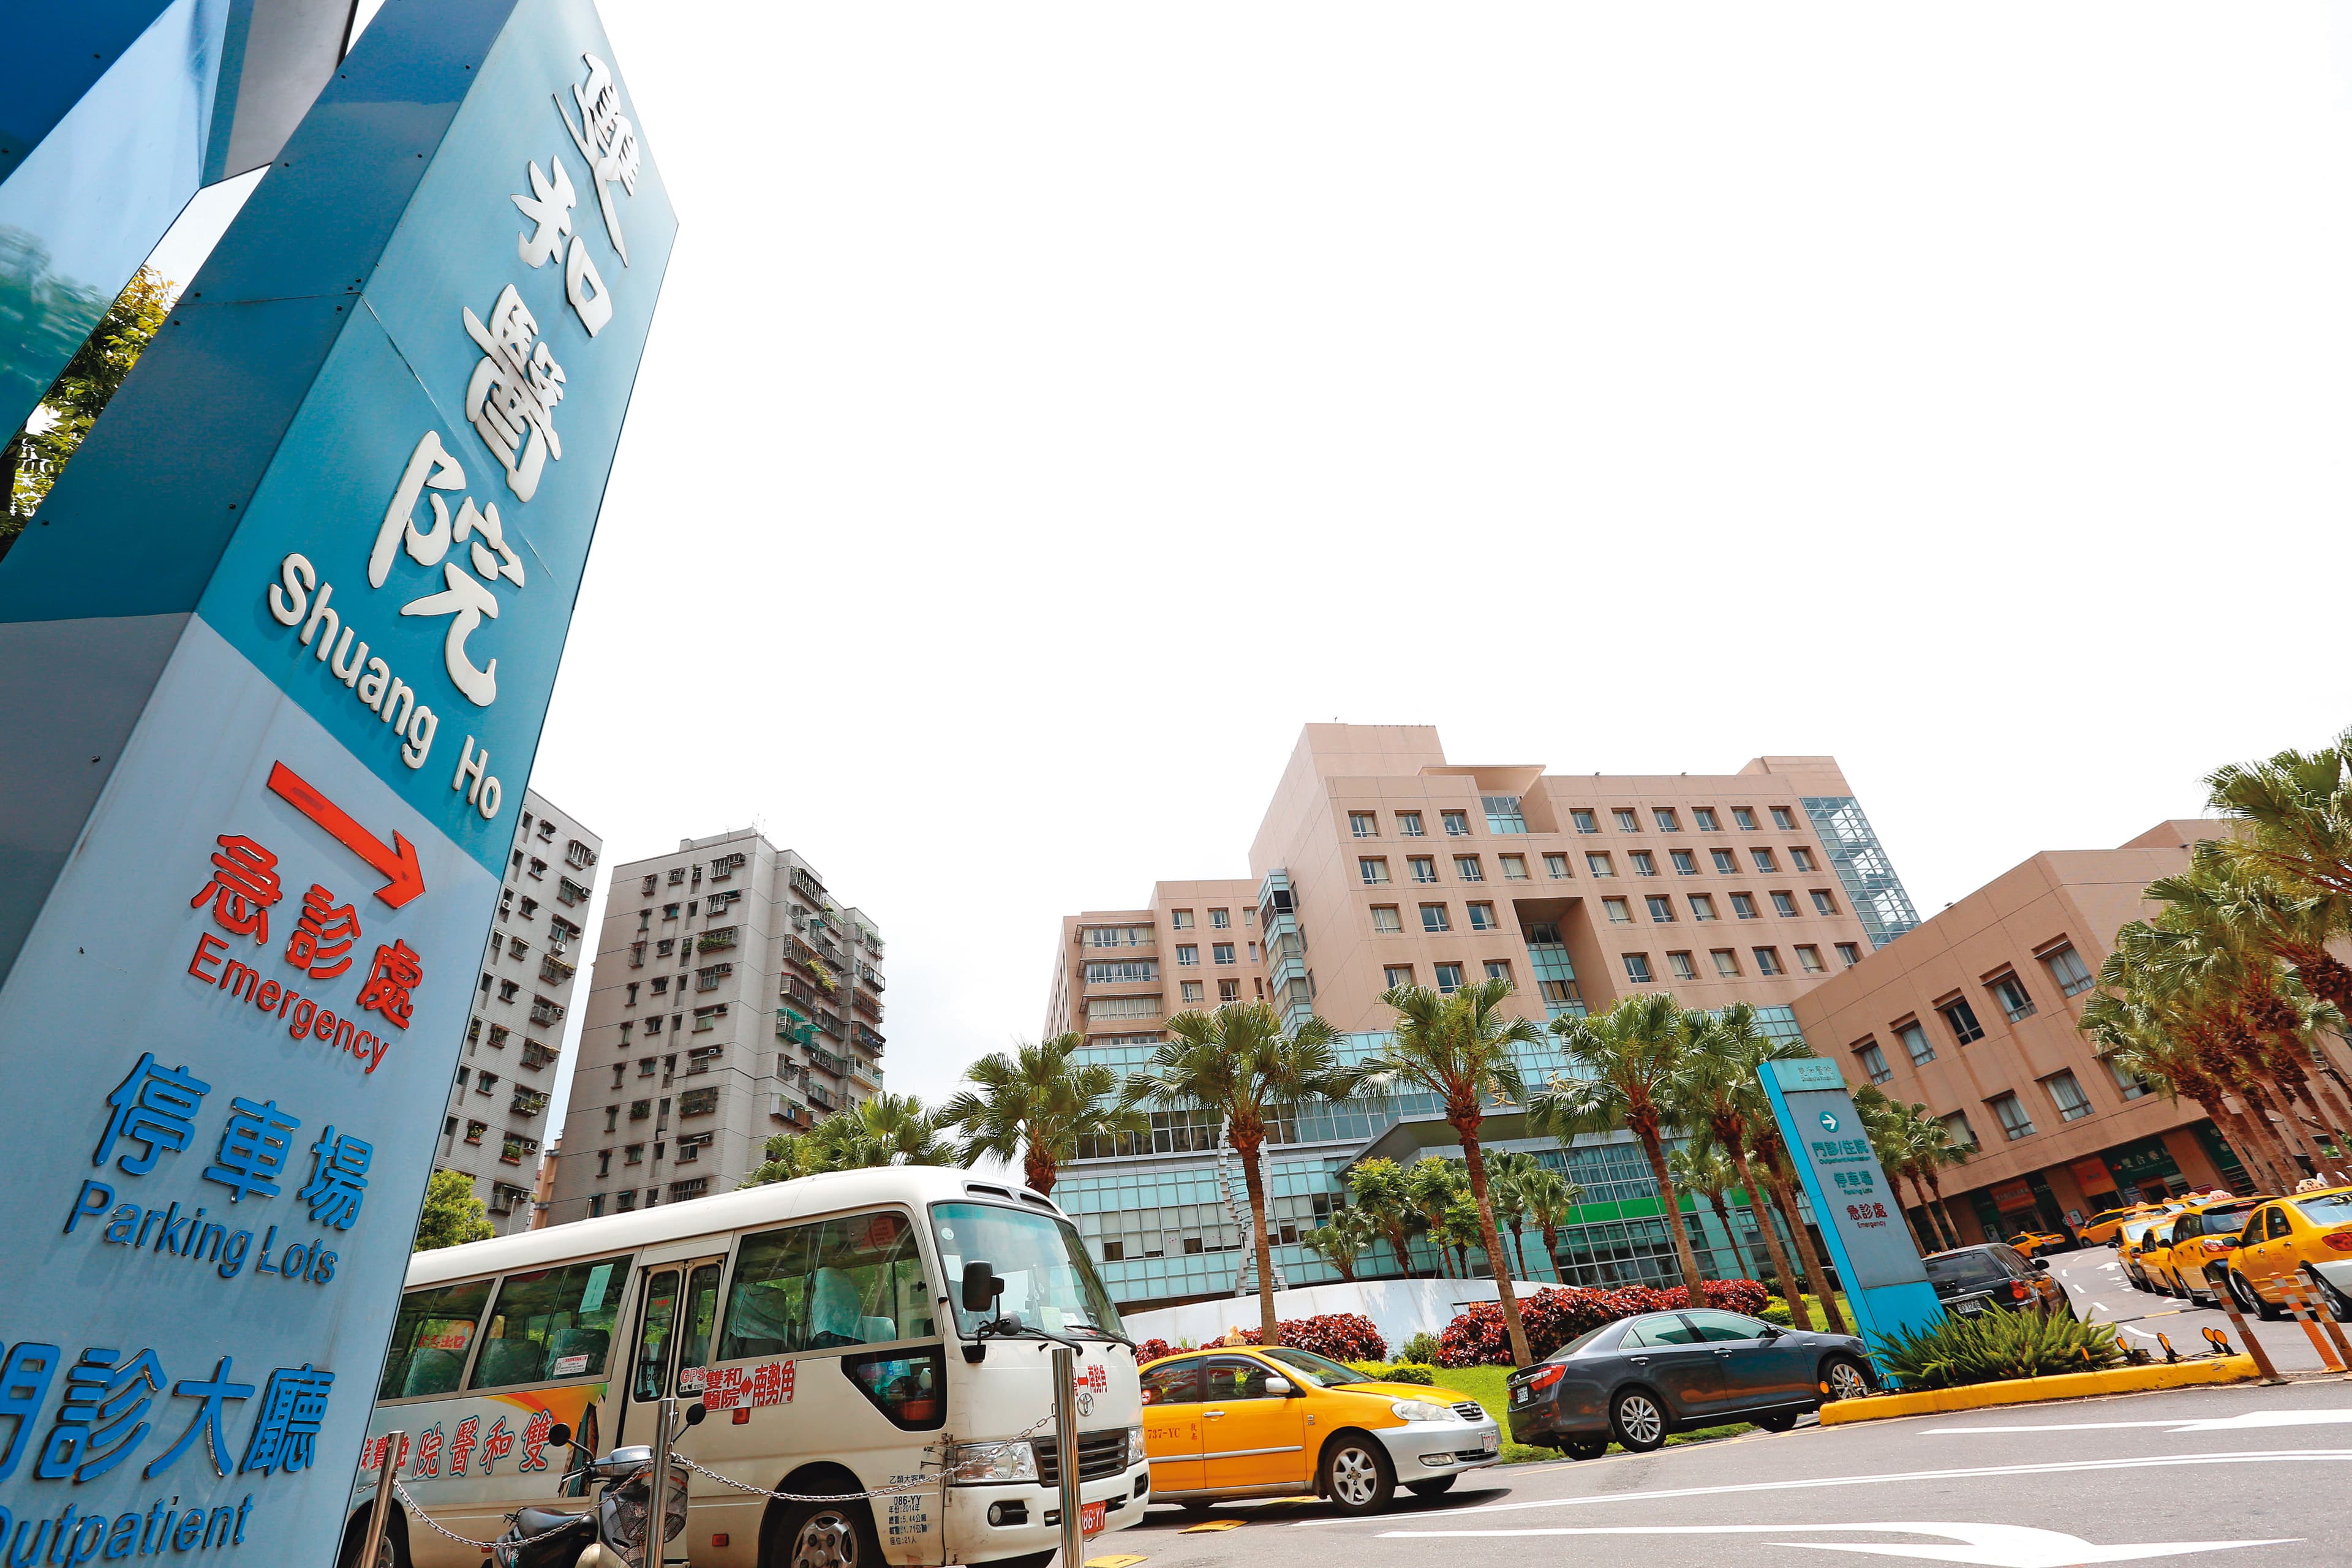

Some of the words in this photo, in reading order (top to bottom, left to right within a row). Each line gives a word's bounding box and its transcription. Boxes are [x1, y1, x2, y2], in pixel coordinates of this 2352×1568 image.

[369, 52, 639, 706] 雙和醫院
[270, 553, 438, 769] Shuang
[453, 734, 502, 819] Ho
[190, 834, 423, 1030] 急診處
[187, 931, 390, 1074] Emergency
[92, 1052, 374, 1230] 停車場
[1811, 1139, 1869, 1157] 門診/住院
[1834, 1170, 1873, 1188] 停車場
[1846, 1202, 1887, 1220] 急診處
[63, 1179, 254, 1278] Parking
[257, 1225, 338, 1284] Lots
[680, 1366, 706, 1383] GPS
[705, 1368, 742, 1390] 雙和
[753, 1360, 795, 1407] 南勢角
[703, 1389, 741, 1409] 醫院
[1147, 1428, 1181, 1439] 737-YC
[894, 1495, 922, 1505] 086-YY
